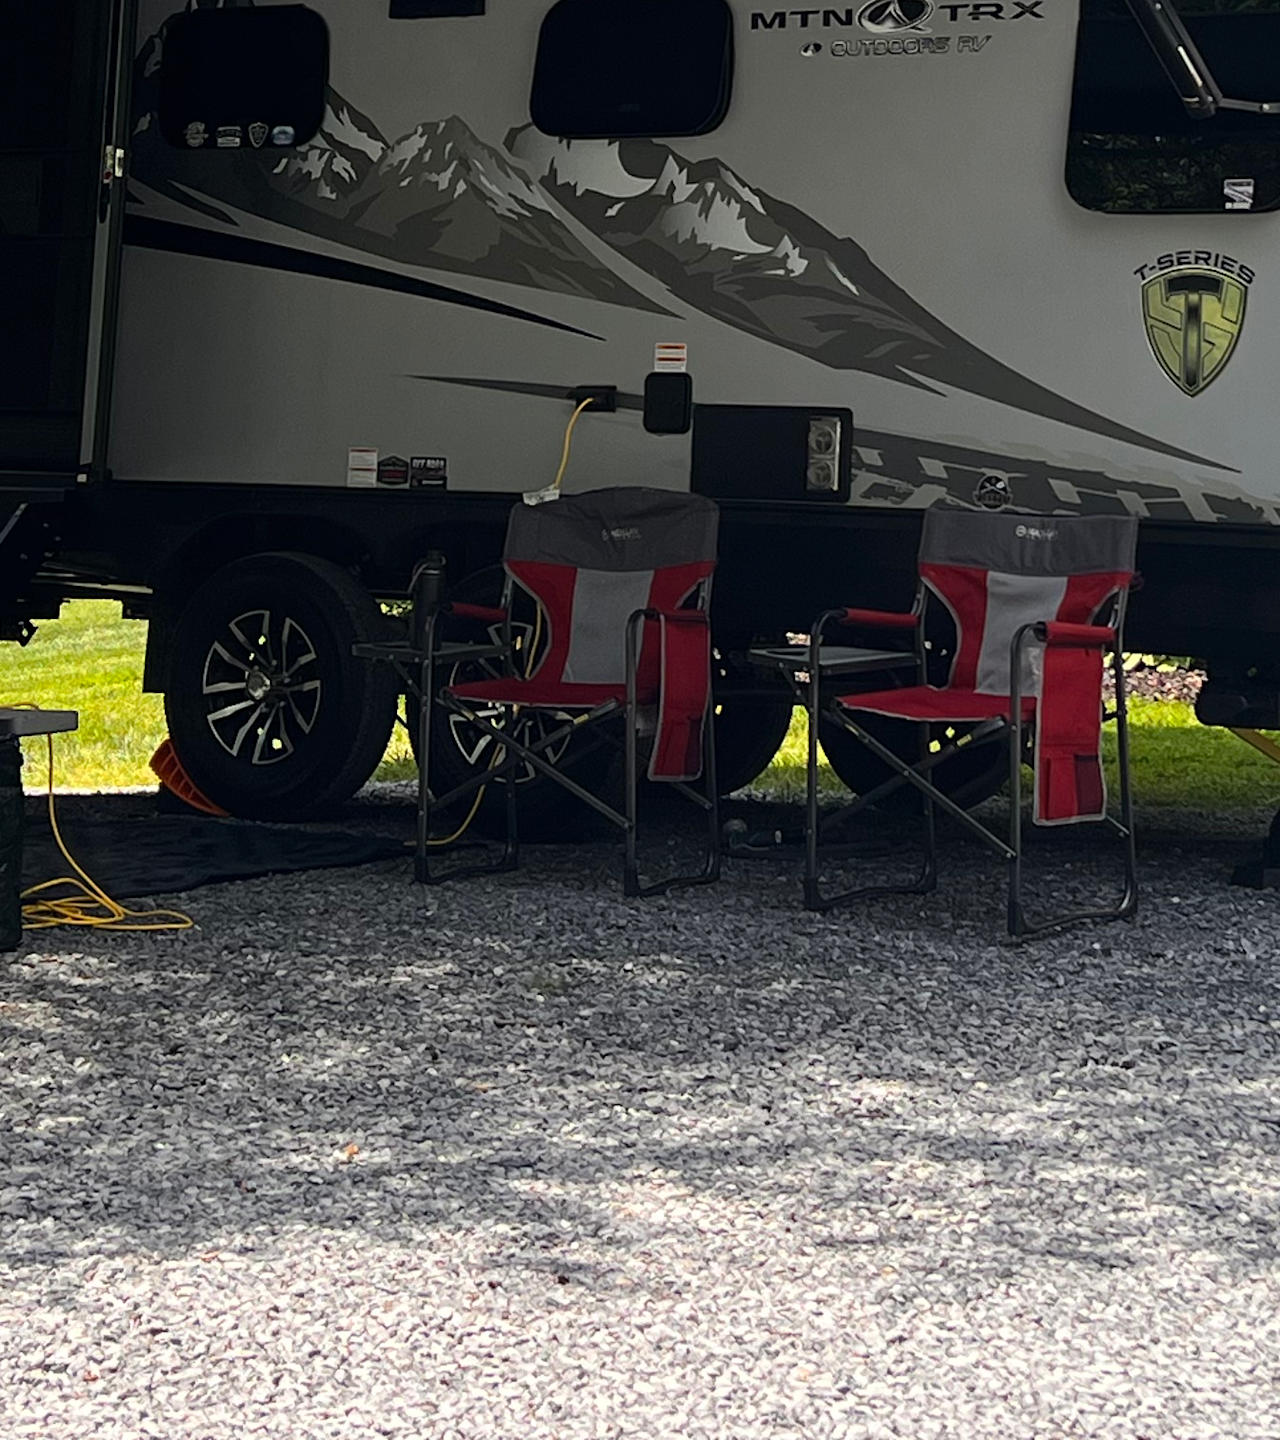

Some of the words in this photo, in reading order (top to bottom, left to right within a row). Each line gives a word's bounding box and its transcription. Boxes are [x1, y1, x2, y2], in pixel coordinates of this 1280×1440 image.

[750, 7, 853, 31] MTN
[939, 0, 1045, 22] TRX
[830, 36, 951, 57] OUTDOORS
[956, 35, 992, 54] RV
[1133, 250, 1256, 285] T-SERIES
